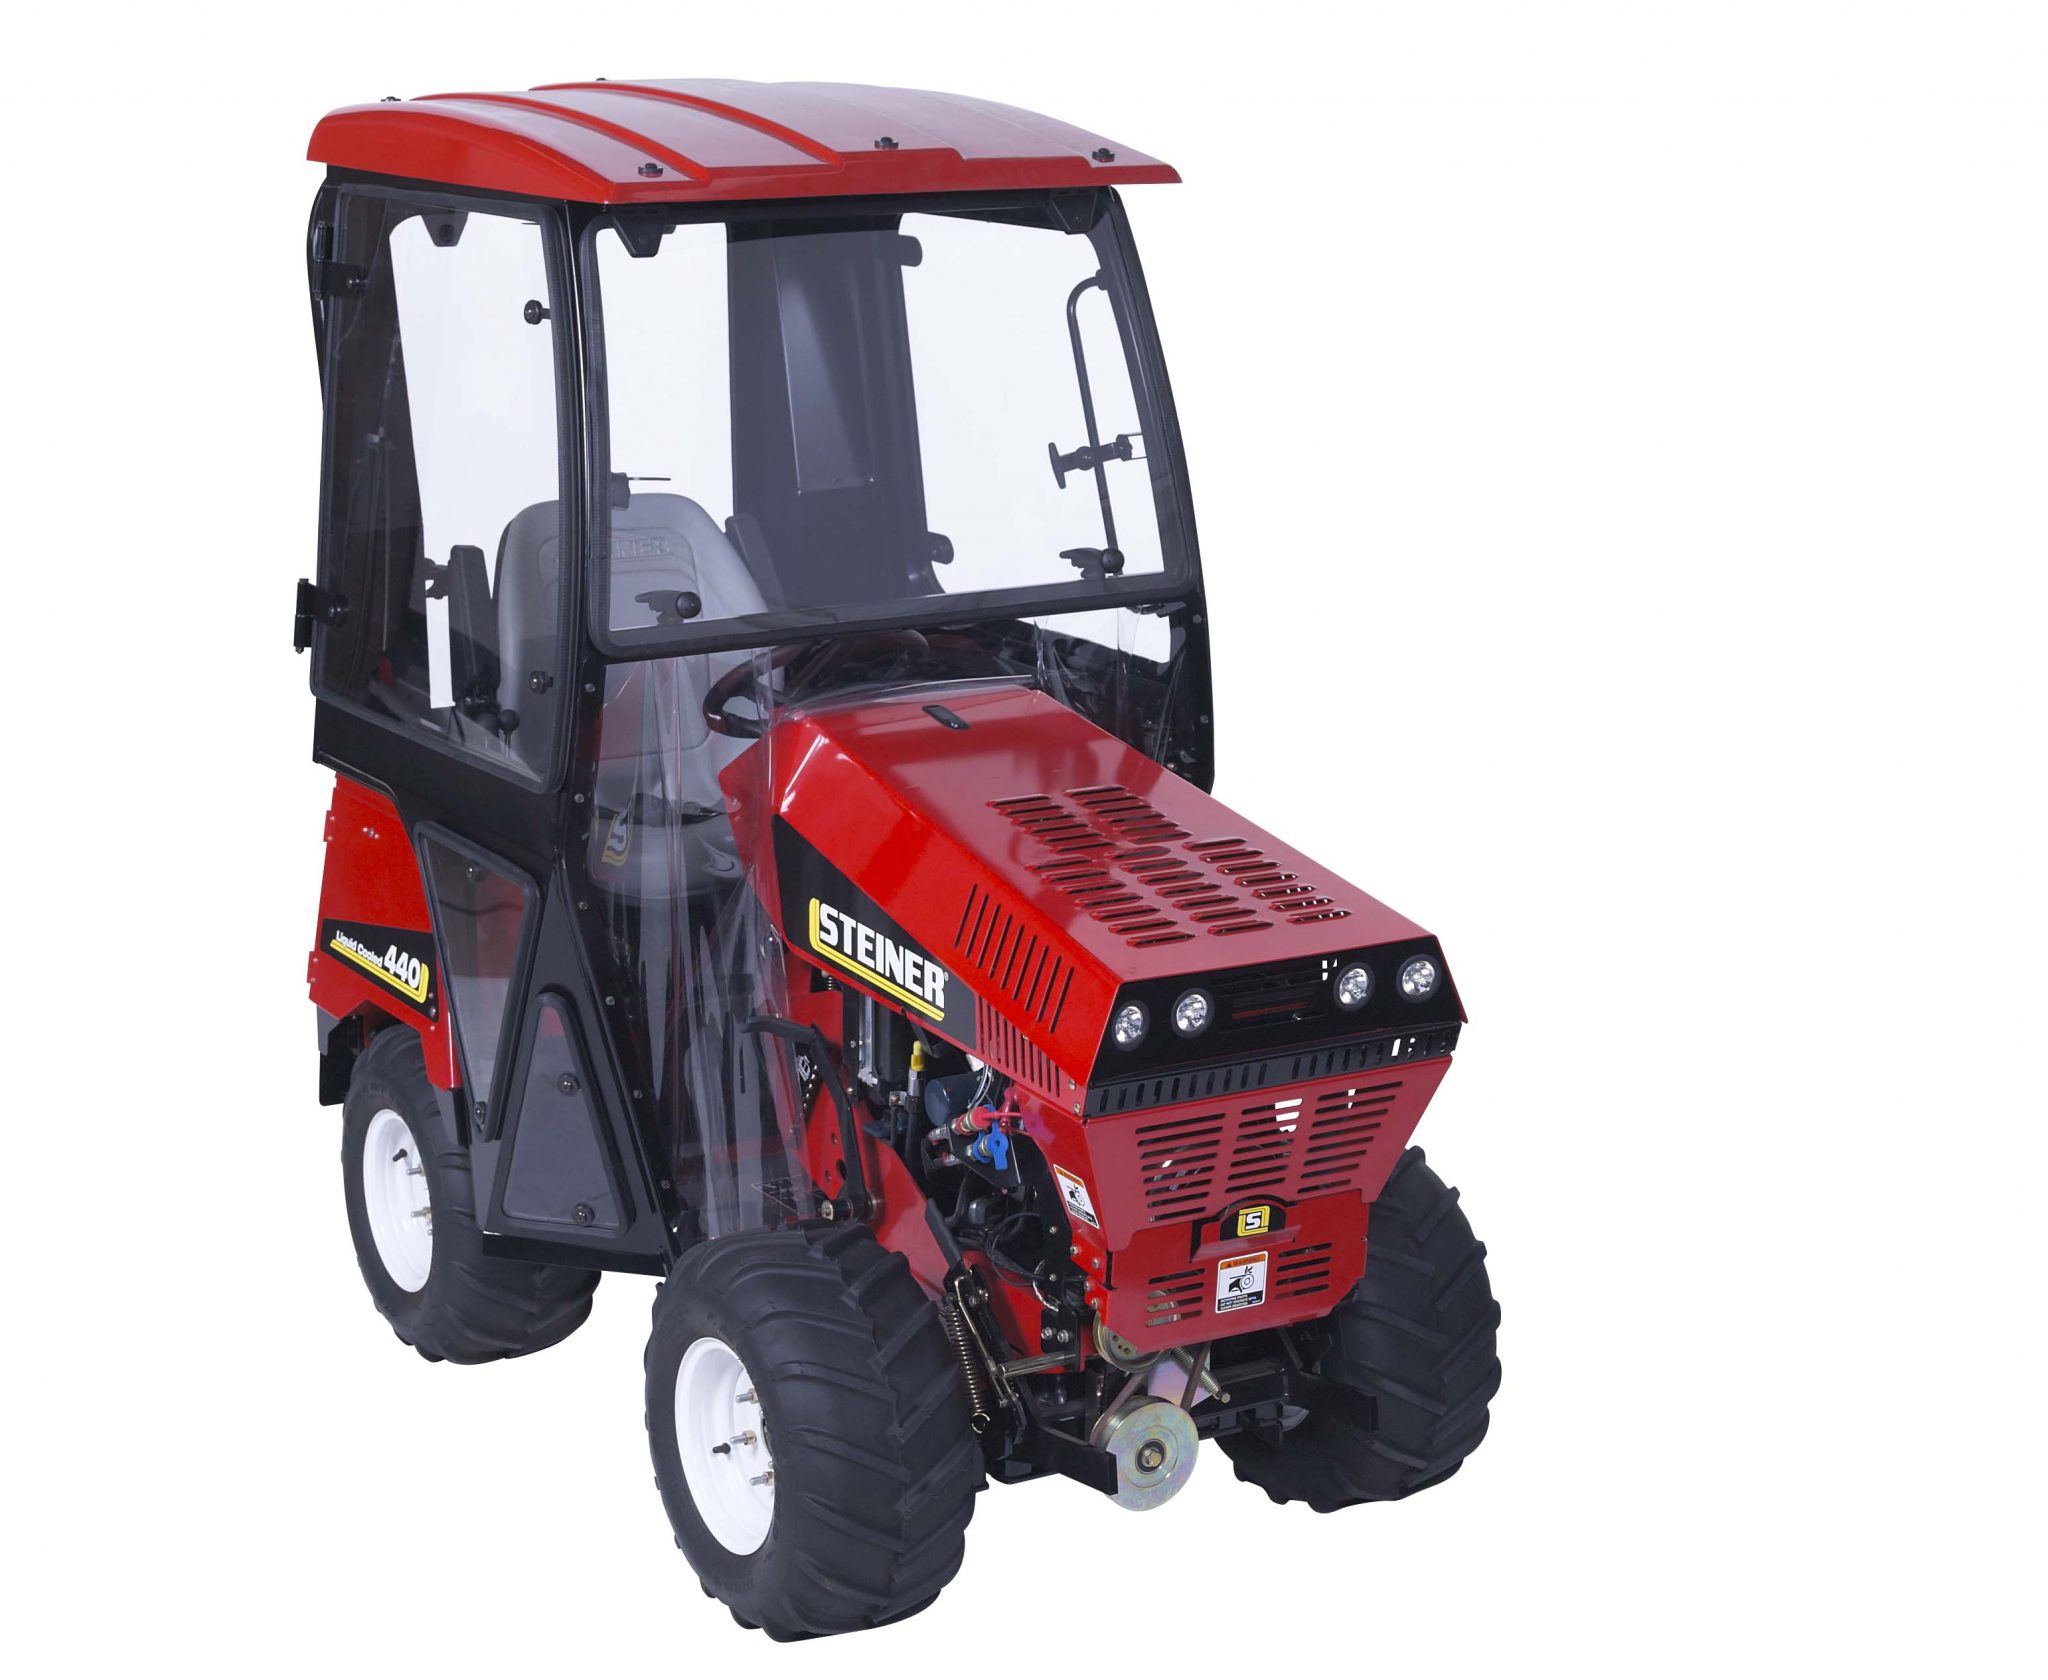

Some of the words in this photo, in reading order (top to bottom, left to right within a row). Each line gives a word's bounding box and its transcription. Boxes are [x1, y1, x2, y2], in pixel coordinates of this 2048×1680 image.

[336, 930, 357, 953] Liquid
[357, 943, 383, 967] Cooled
[384, 945, 421, 989] 440
[819, 903, 945, 1009] STEINER
[1245, 1212, 1261, 1230] S
